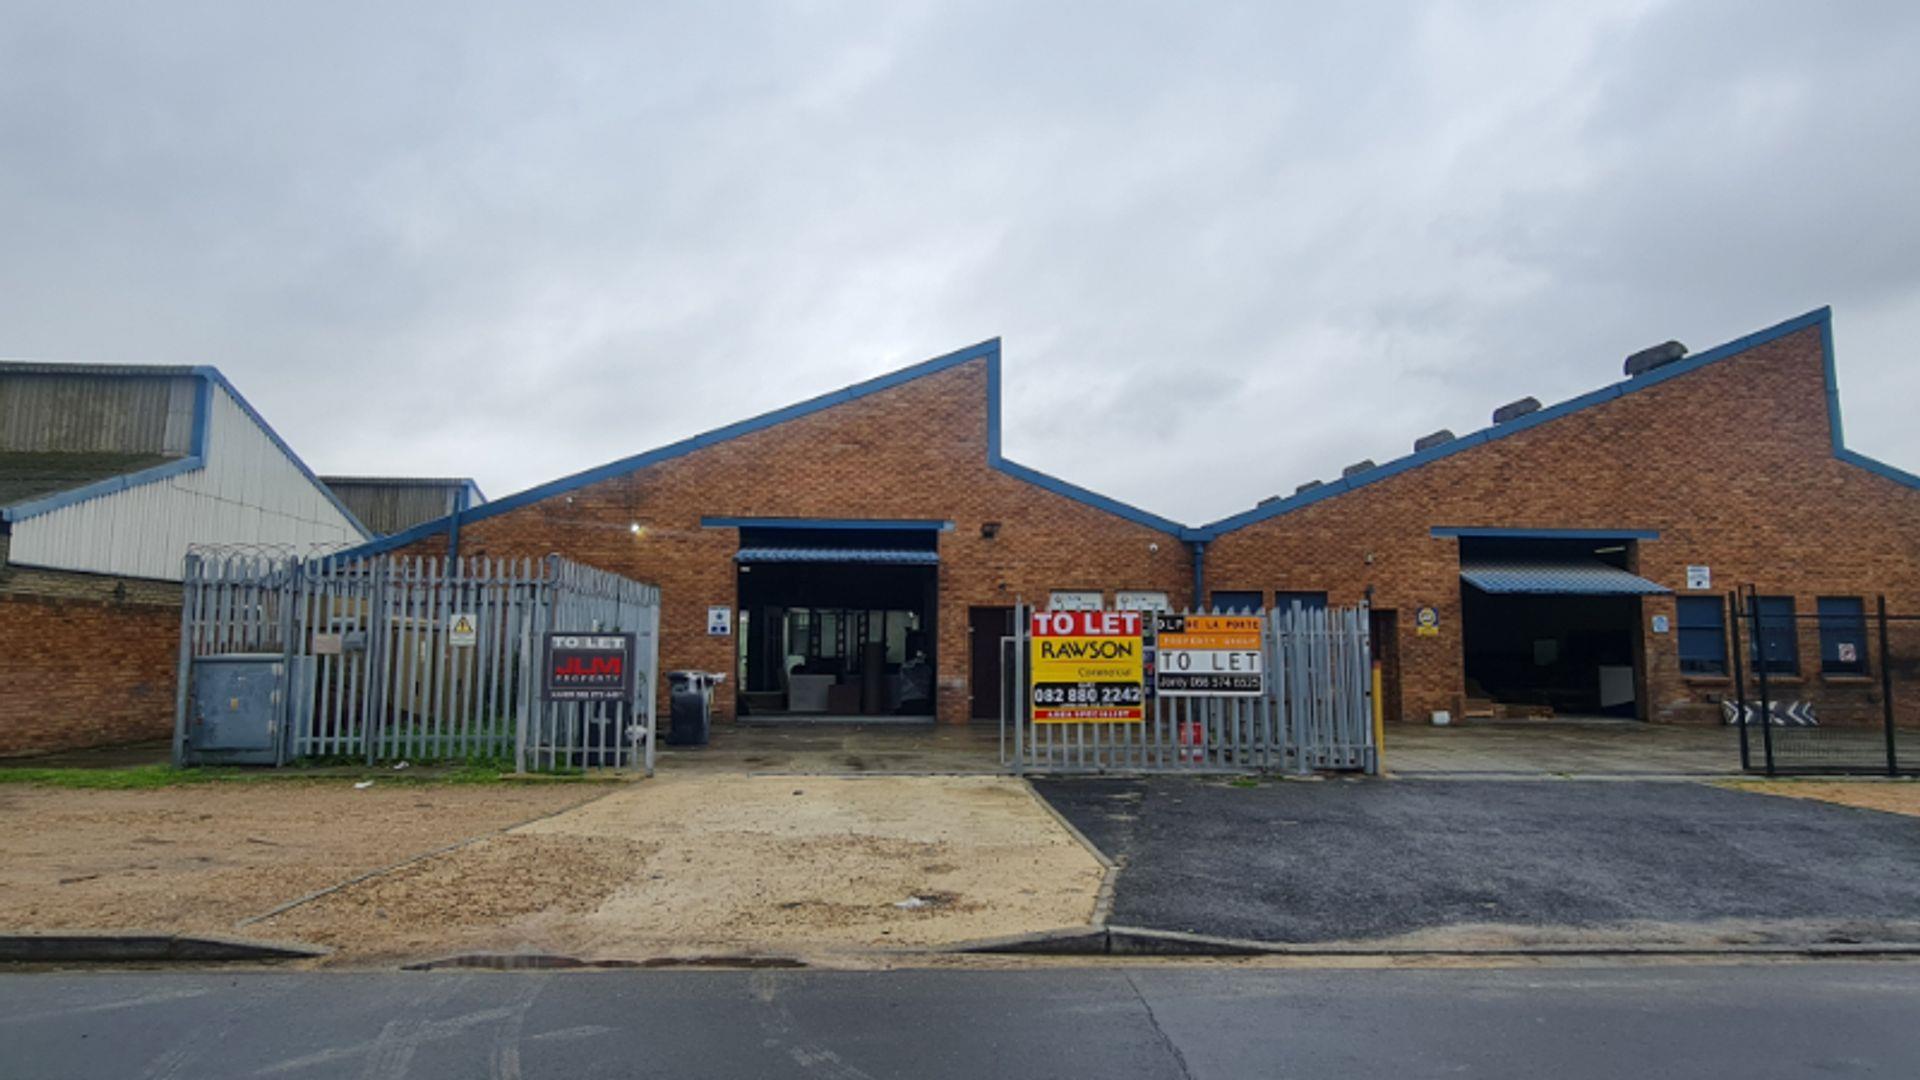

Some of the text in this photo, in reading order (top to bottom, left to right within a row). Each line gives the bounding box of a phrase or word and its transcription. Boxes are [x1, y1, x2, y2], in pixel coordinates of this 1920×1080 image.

[1033, 612, 1140, 634] TO LET
[1226, 620, 1259, 630] PORTE
[552, 636, 625, 648] TO LET
[1041, 641, 1132, 659] RAWSON
[555, 656, 622, 675] JLM
[1162, 652, 1258, 671] TO LET
[556, 674, 619, 682] PROPERTY
[1034, 688, 1065, 702] 082
[1101, 686, 1141, 702] 2242
